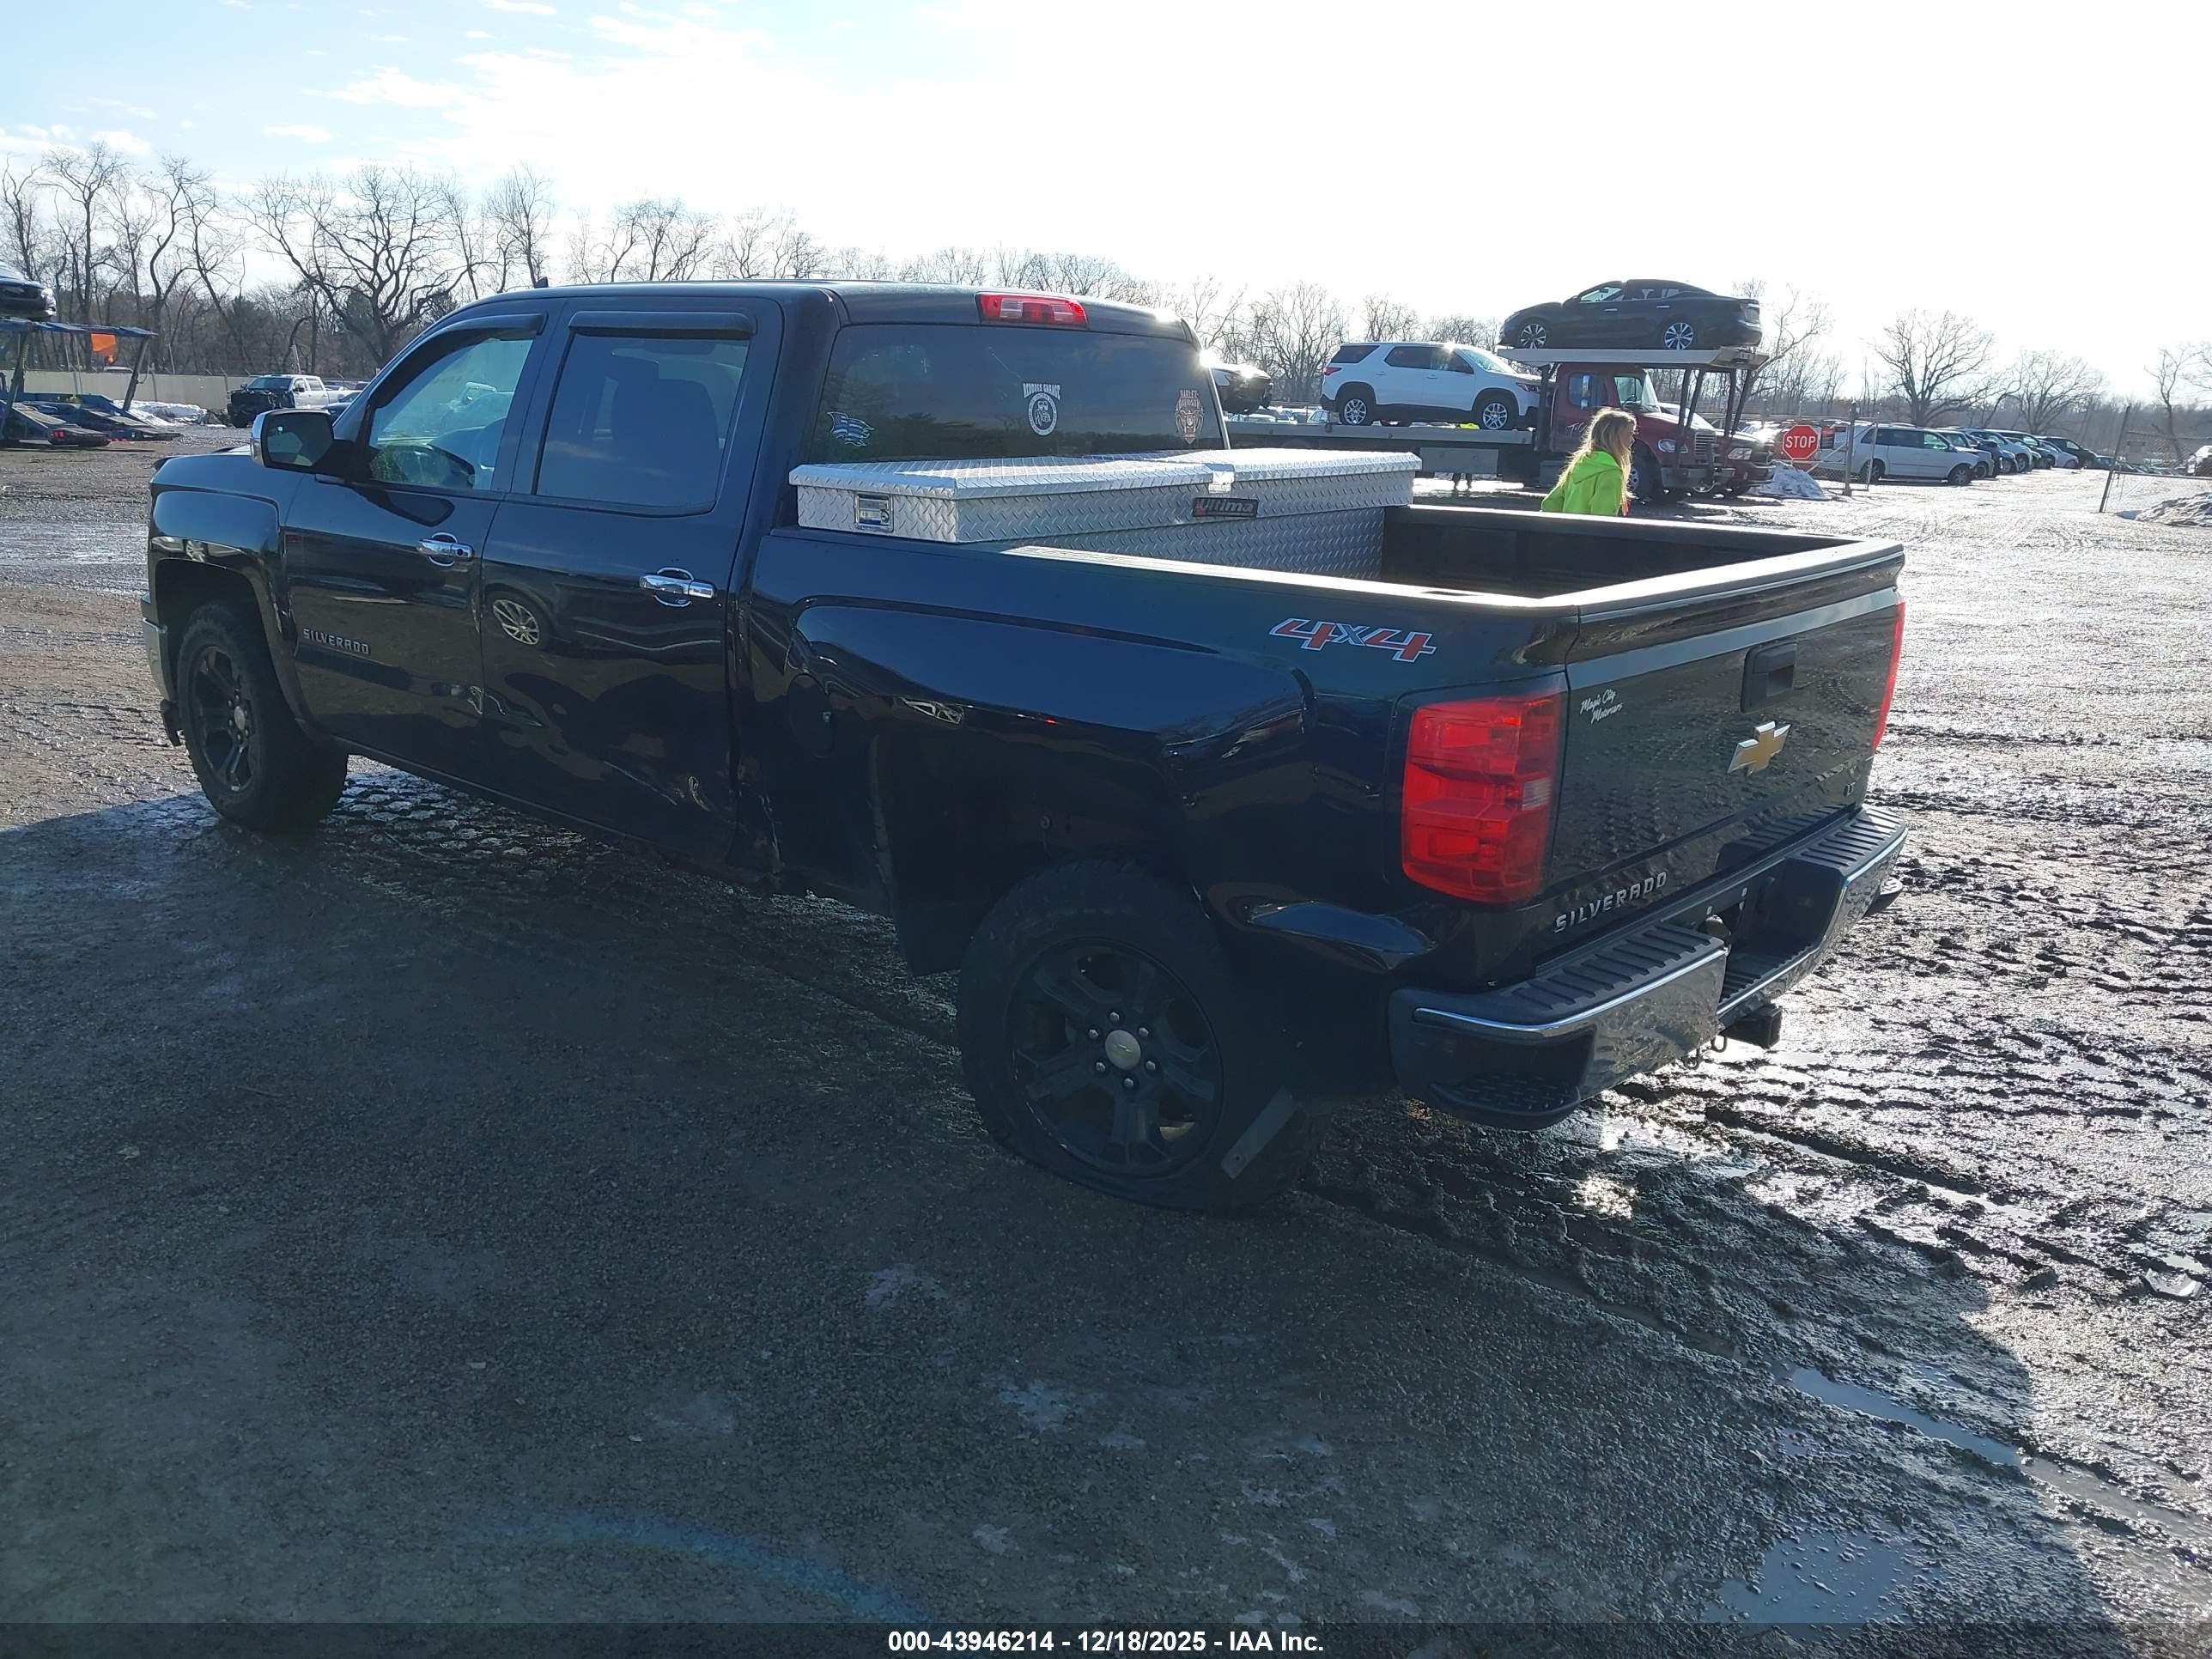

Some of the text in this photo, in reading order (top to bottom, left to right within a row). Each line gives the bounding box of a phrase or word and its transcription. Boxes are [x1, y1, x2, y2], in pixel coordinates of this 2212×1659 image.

[1786, 435, 1816, 448] STOP
[303, 628, 369, 654] SILVERADO
[1602, 689, 1616, 704] City
[1553, 872, 1667, 933] SILVERADO
